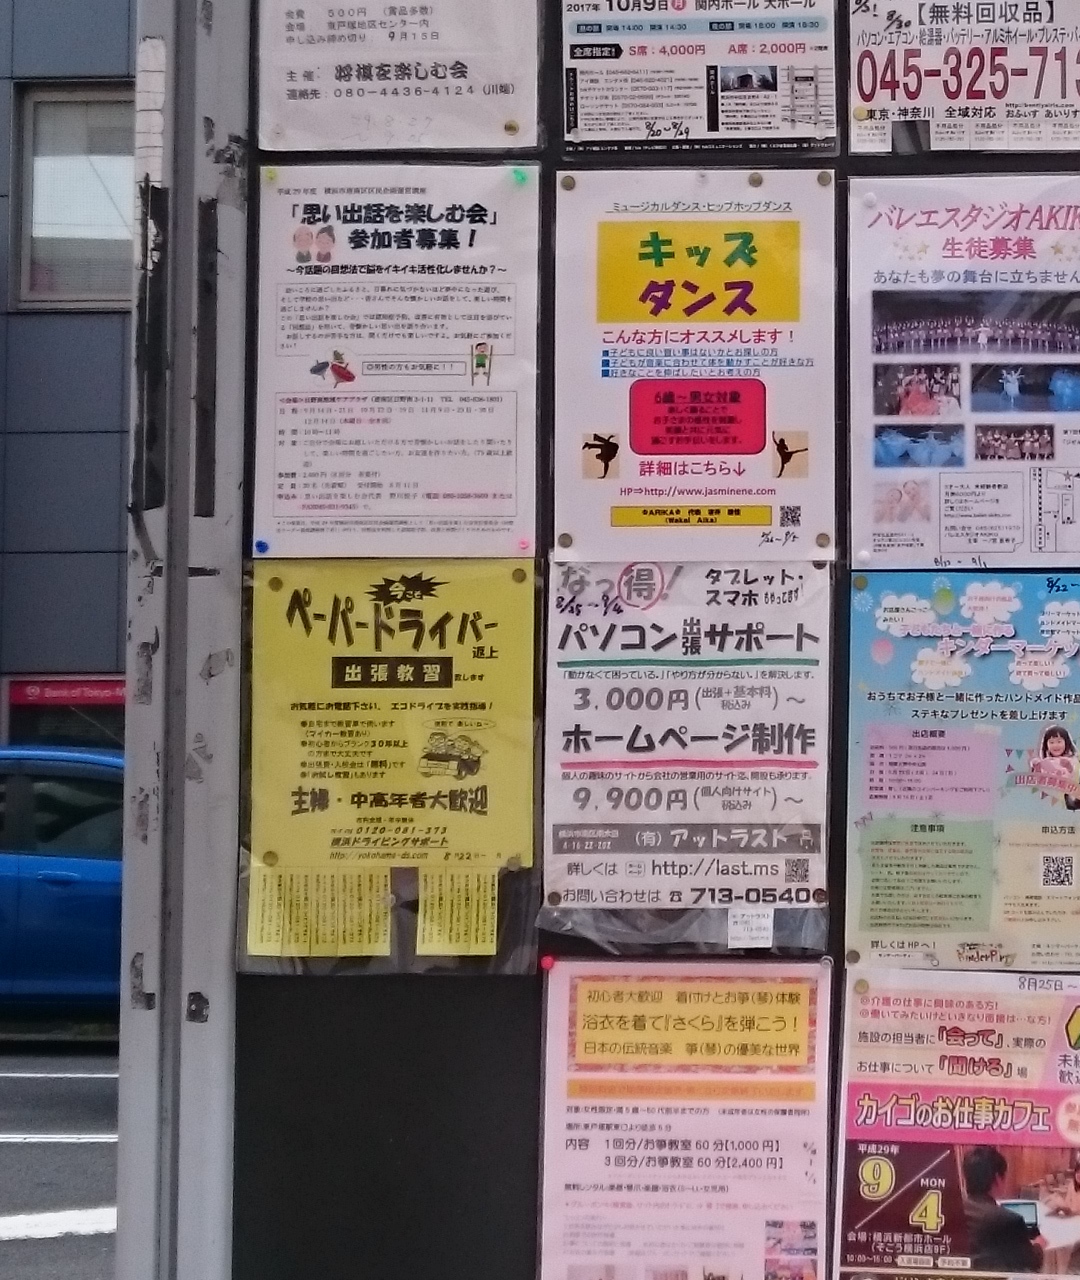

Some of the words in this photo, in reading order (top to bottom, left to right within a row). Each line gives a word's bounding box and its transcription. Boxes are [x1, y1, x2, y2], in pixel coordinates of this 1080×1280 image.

[916, 0, 1056, 25] 【無料回収品】
[574, 47, 611, 57] 全席指定
[334, 61, 469, 82] 将棋を楽しむ会
[866, 106, 935, 121] 東京・神奈川
[944, 106, 996, 119] 全域対応
[1044, 107, 1080, 118] あいりす
[290, 202, 500, 225] 「思い出話を楽しむ会」
[348, 228, 477, 251] 参加者募集！
[941, 236, 1037, 260] 生徒募集
[638, 230, 758, 268] キッズ
[638, 279, 758, 318] ダンス
[602, 328, 795, 345] こんな方にオススメします！
[639, 460, 735, 477] 詳細はこちら
[644, 485, 776, 497] http://www.jasminene.com
[389, 583, 423, 601] 今こそ
[706, 588, 759, 606] スマホ
[285, 586, 499, 653] ペーパードライバー
[557, 616, 820, 656] パソコン出張サポート
[472, 645, 499, 660] 返上
[344, 664, 441, 683] 出張教習
[573, 686, 690, 712] 3,000円
[910, 708, 1069, 721] ステキなプレゼントを差し上げます
[561, 722, 817, 756] ホームページ制作
[912, 729, 946, 739] 出店概要
[572, 786, 688, 812] 9,900円
[700, 785, 772, 798] 個人向けサイト
[290, 786, 489, 816] 主婦・中高年者大歓迎
[670, 827, 787, 848] アットラスト
[910, 824, 945, 833] 注意事項
[1041, 825, 1076, 835] 申込方法
[330, 836, 449, 848] 横浜ドライビングサポート
[567, 861, 618, 877] 詳しくは
[651, 858, 780, 877] http://last.ms
[562, 889, 662, 904] お問い合わせは
[690, 887, 812, 905] 713-0540
[587, 990, 663, 1004] 初心者大歓迎
[584, 1042, 673, 1055] 日本の伝統音楽
[856, 1092, 1052, 1132] カイゴのお仕事カフェ
[565, 1138, 590, 1151] 内容
[859, 1157, 896, 1200] 9
[920, 1178, 946, 1188] MON
[909, 1189, 945, 1233] 4
